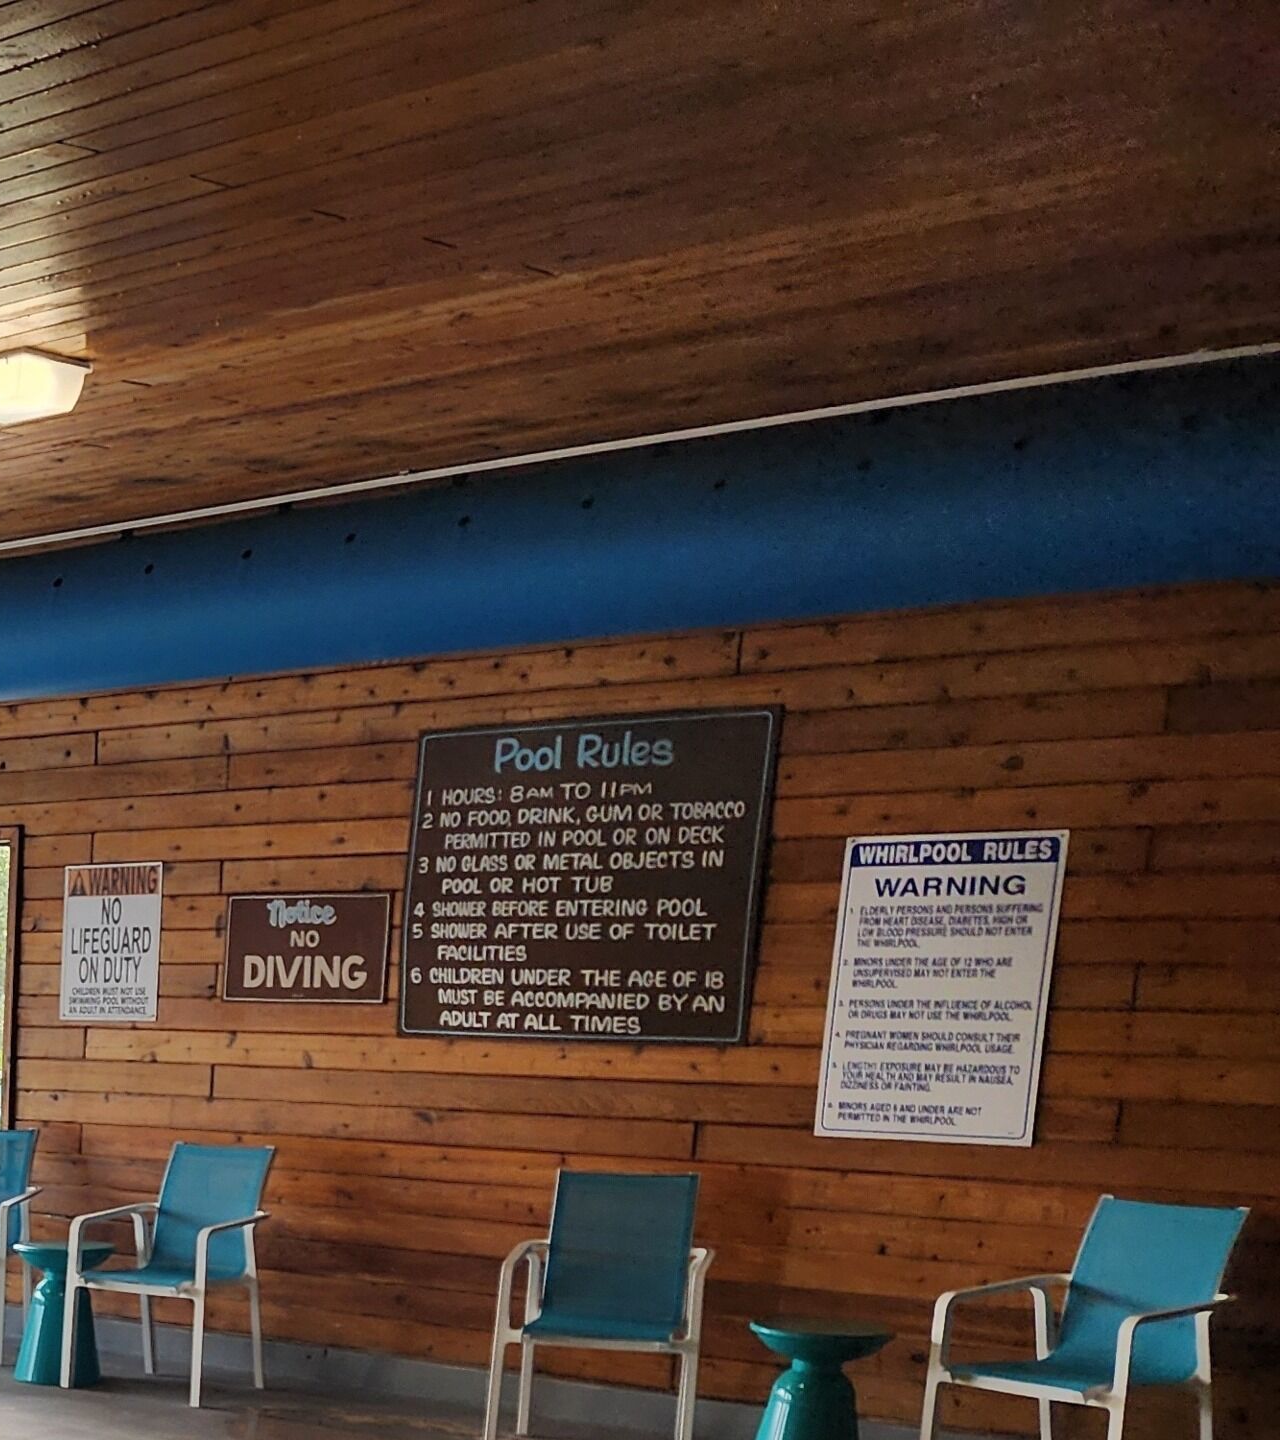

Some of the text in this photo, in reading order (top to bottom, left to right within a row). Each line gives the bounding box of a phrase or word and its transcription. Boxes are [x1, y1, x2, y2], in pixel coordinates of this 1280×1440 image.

[494, 731, 675, 774] Pool Rules
[427, 781, 653, 806] 1 HOURS: 8AM TO 11PM
[422, 813, 433, 829] 2
[440, 811, 461, 828] NO
[517, 806, 581, 826] DRINK,
[586, 804, 632, 822] GUM
[638, 803, 663, 821] OR
[670, 801, 745, 820] TOBACCO
[444, 825, 725, 850] PERMITTED IN POOL OR ON DECK
[418, 849, 724, 874] 3 NO GLASS OR METAL OBJECTS IN
[859, 840, 1052, 865] WHIRLPOOL RULES
[91, 867, 158, 895] WARNING
[442, 876, 614, 895] POOL OR HOT TUB
[874, 875, 1027, 898] WARNING
[101, 897, 122, 924] NO
[267, 900, 338, 928] Notice
[414, 898, 707, 917] 4 SHOWER BEFORE ENTERING POOL
[860, 904, 993, 915] ELDERLY PERSONS AND PERSONS
[71, 926, 151, 954] LIFEGUARD
[289, 930, 320, 948] NO
[412, 923, 718, 940] 5 SHOWER AFTER USE OF TOILET
[876, 926, 1032, 937] BLOOD PRESSURE SHOULD NOT ENTER
[437, 945, 527, 961] FACILITIES
[854, 957, 1013, 967] MINORS UNDER THE AGE OF 12 WHO ARE
[79, 956, 142, 983] ON DUTY
[243, 954, 368, 989] DIVING
[410, 967, 724, 989] 6 CHILDREN UNDER THE AGE OF 18
[853, 968, 995, 978] UNSUPERVISED MAY NOT ENTER THE
[72, 987, 146, 995] CHILDREN MUST NOT USE
[438, 988, 725, 1013] MUST BE ACCOMPANIED BY AN
[79, 1006, 97, 1014] ADULT
[103, 997, 119, 1005] POOL
[121, 997, 148, 1005] WITHOUT
[849, 999, 1032, 1010] PERSONS UNDER THE INFLUENCE OF ALCOHOL
[440, 1010, 641, 1034] ADULT AT ALL TIMES
[848, 1010, 960, 1020] OR DRUGS MAY NOT USE THE
[846, 1030, 1021, 1042] PREGNANT WOMEN SHOULD CONSULT THEIR
[844, 1041, 981, 1053] PHYSICIAN REGARDING WHIRLPOOL
[838, 1102, 982, 1116] MINORS AGED AND UNDER ARE NOT
[838, 1112, 906, 1123] PERMITTED THE
